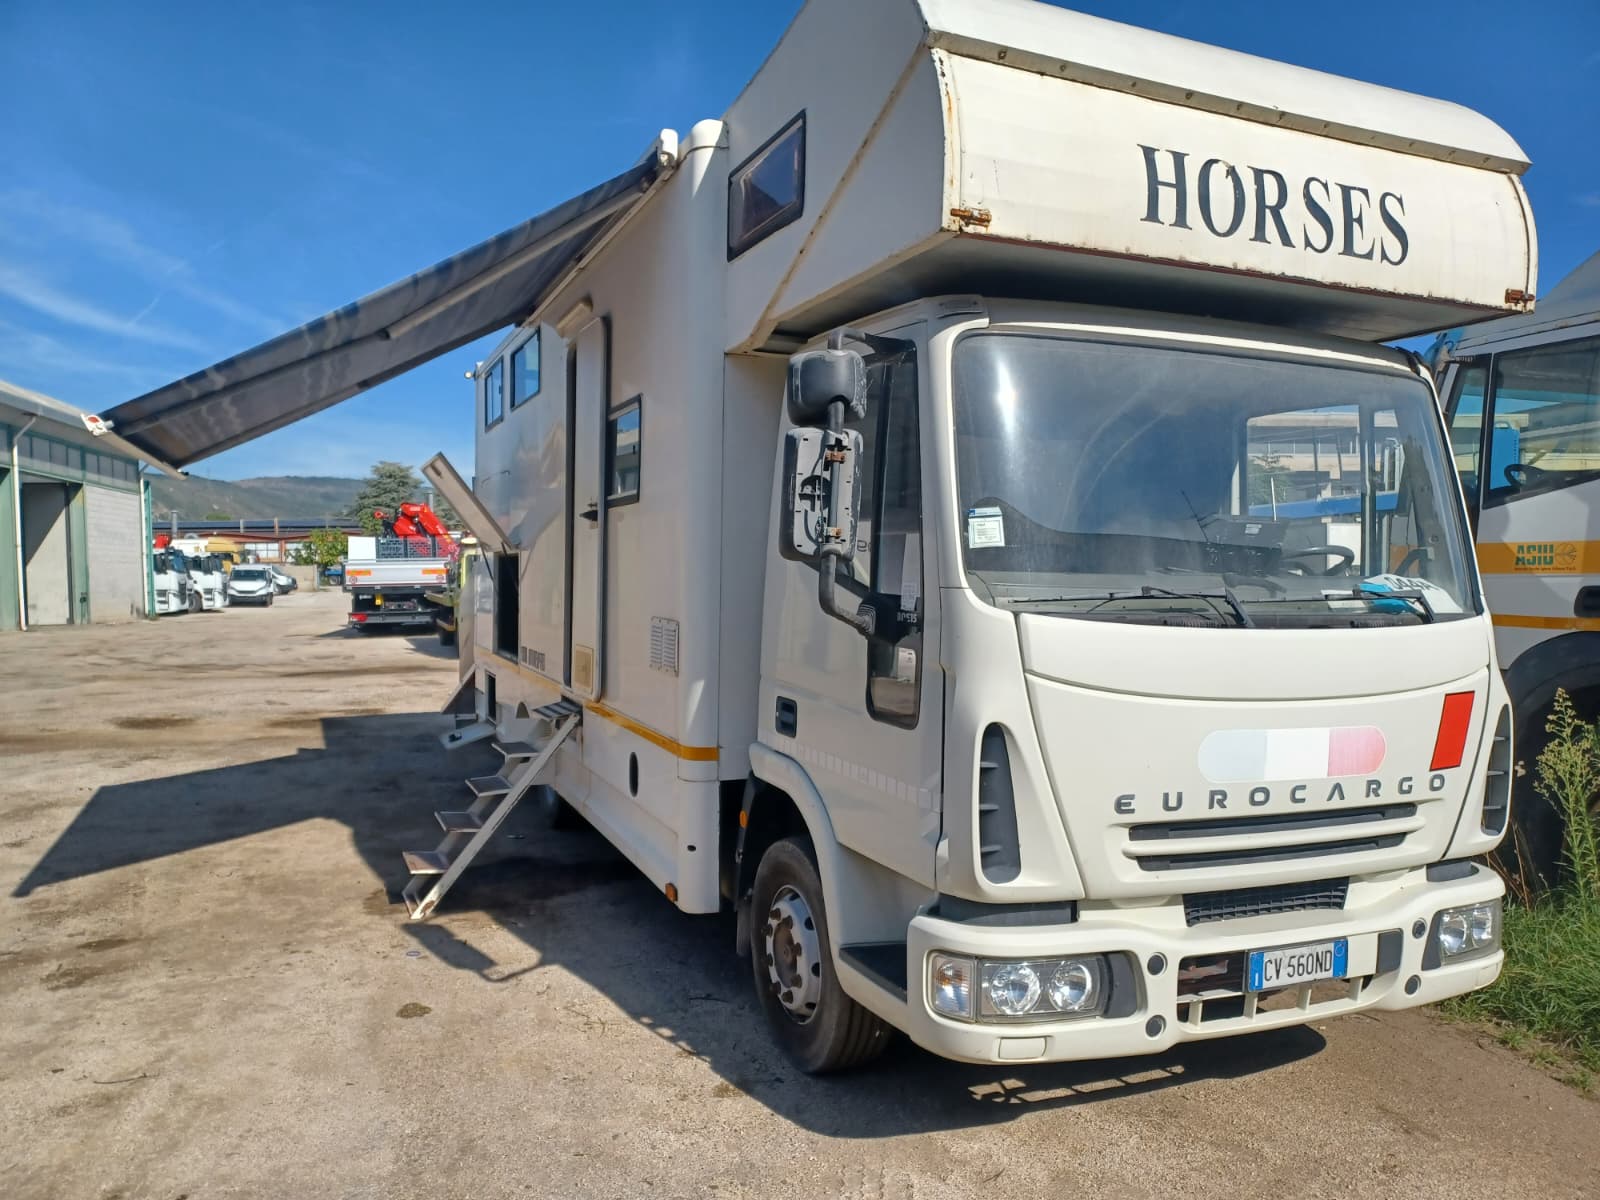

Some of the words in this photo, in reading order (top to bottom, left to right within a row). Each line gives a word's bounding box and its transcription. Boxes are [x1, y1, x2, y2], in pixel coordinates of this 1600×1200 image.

[1137, 143, 1409, 266] HORSES
[1114, 774, 1446, 815] EUROCARGO
[1264, 957, 1283, 982] CV
[1287, 950, 1332, 978] 560ND
